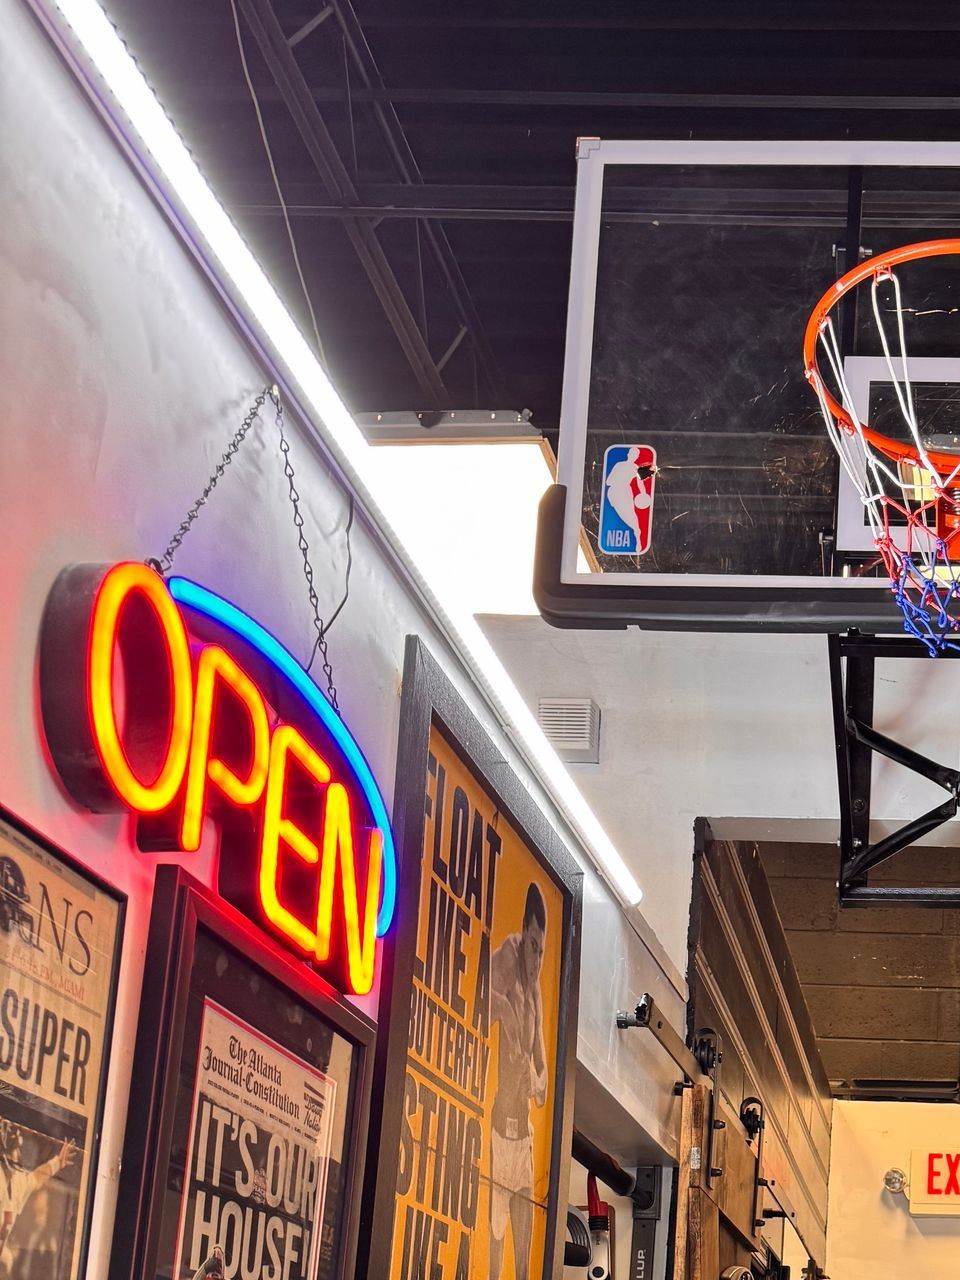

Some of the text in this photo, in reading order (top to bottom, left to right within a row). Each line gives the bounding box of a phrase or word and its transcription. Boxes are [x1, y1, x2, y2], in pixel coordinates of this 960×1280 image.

[606, 530, 630, 547] NBA
[88, 561, 384, 995] OPEN
[37, 881, 94, 977] NS
[413, 876, 491, 1040] IKE A
[0, 987, 91, 1106] SUPER
[204, 1047, 299, 1117] Journal-Constitution
[229, 1036, 281, 1085] The Atlanta
[408, 984, 490, 1103] BUTTERFLY
[197, 1103, 256, 1195] IT'S
[264, 1132, 318, 1218] OUR
[396, 1072, 482, 1230] STING
